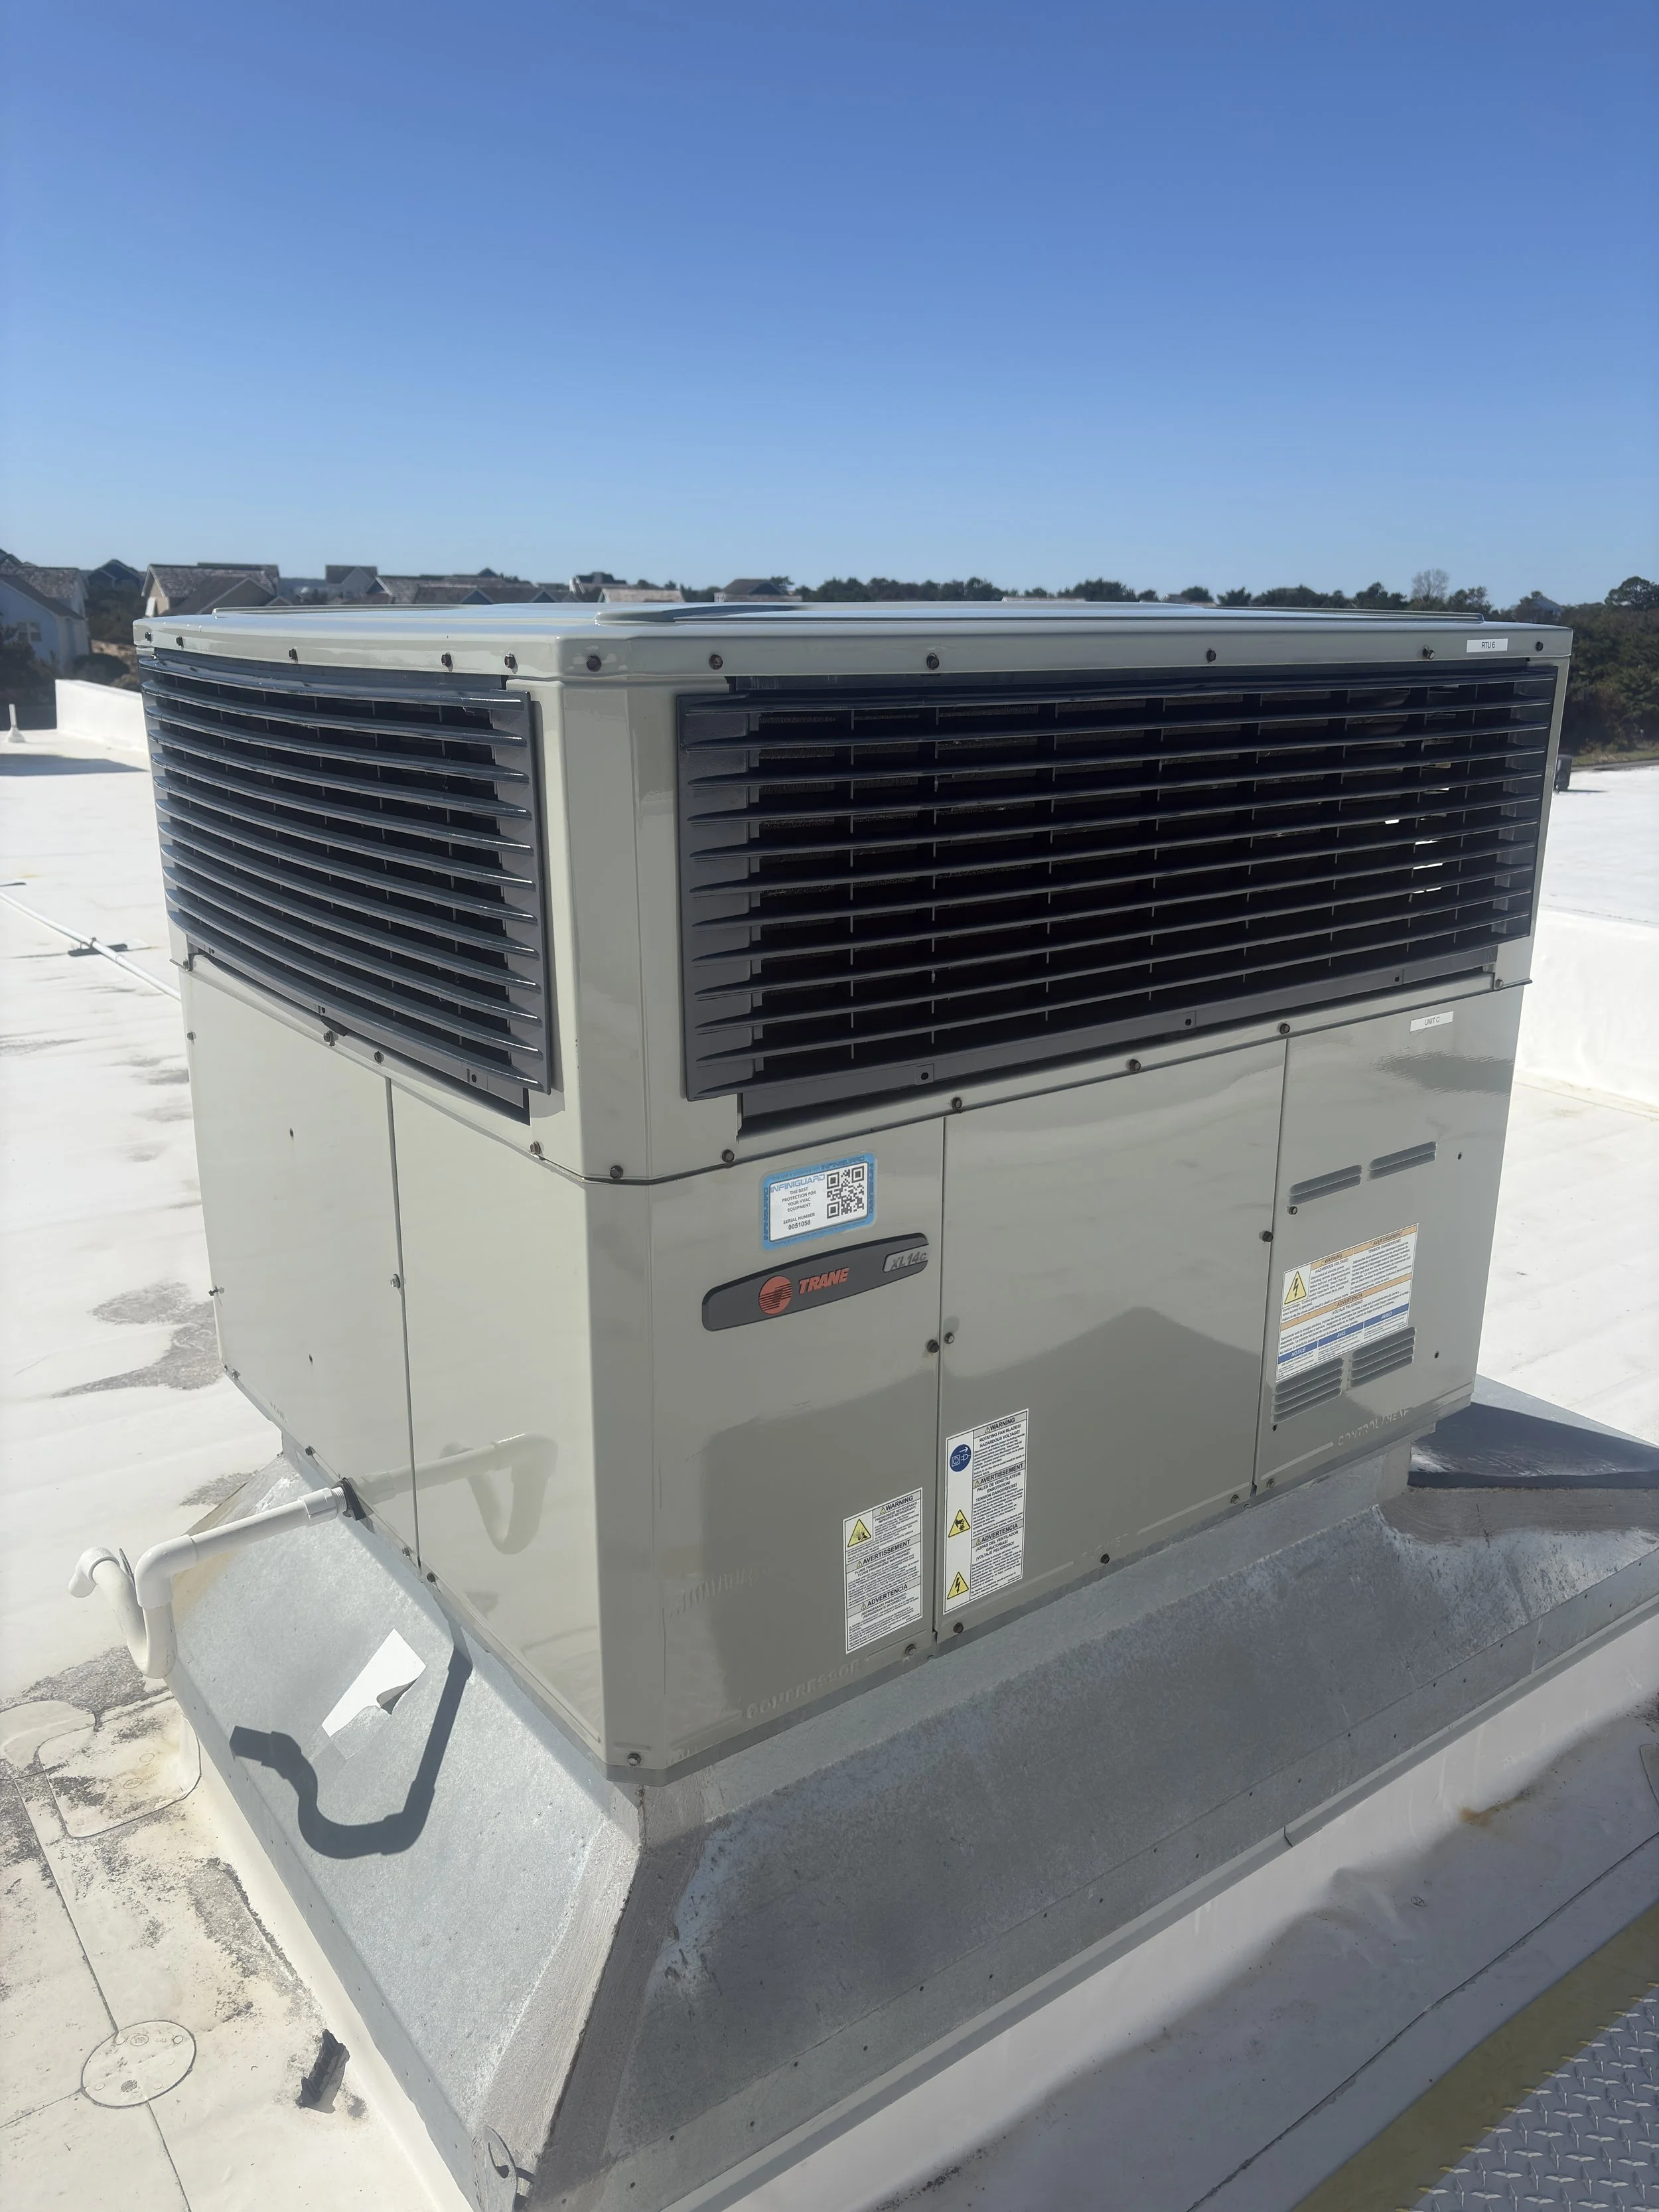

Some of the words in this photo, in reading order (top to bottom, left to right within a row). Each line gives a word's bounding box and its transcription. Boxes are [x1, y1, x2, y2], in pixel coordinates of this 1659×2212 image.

[770, 1173, 824, 1193] INFINIGUARD
[782, 1192, 807, 1202] PROTECTION
[787, 1203, 810, 1212] EQUIPMENT
[788, 1219, 810, 1230] 0051058
[1373, 1231, 1402, 1246] AVERTISSEMENT
[890, 1255, 906, 1270] XL
[1325, 1253, 1342, 1263] WARNING
[799, 1267, 849, 1294] TRANE
[1336, 1293, 1362, 1306] ADVERTENCIA
[1381, 1311, 1392, 1319] AVISO
[1291, 1347, 1305, 1357] NOTICE
[990, 1416, 1015, 1431] WARNING
[979, 1432, 997, 1443] ROTATING
[1005, 1423, 1021, 1432] BLADES!
[979, 1436, 1001, 1448] HAZARDOUS
[1003, 1429, 1020, 1439] VOLTAGE!
[981, 1462, 1023, 1484] AVERTISSEMENT
[886, 1495, 912, 1511] WARNING
[981, 1522, 1017, 1542] ADVERTENCIA
[863, 1538, 910, 1565] AVERTISSEMENT
[867, 1583, 907, 1607] ADVERTENCIA
